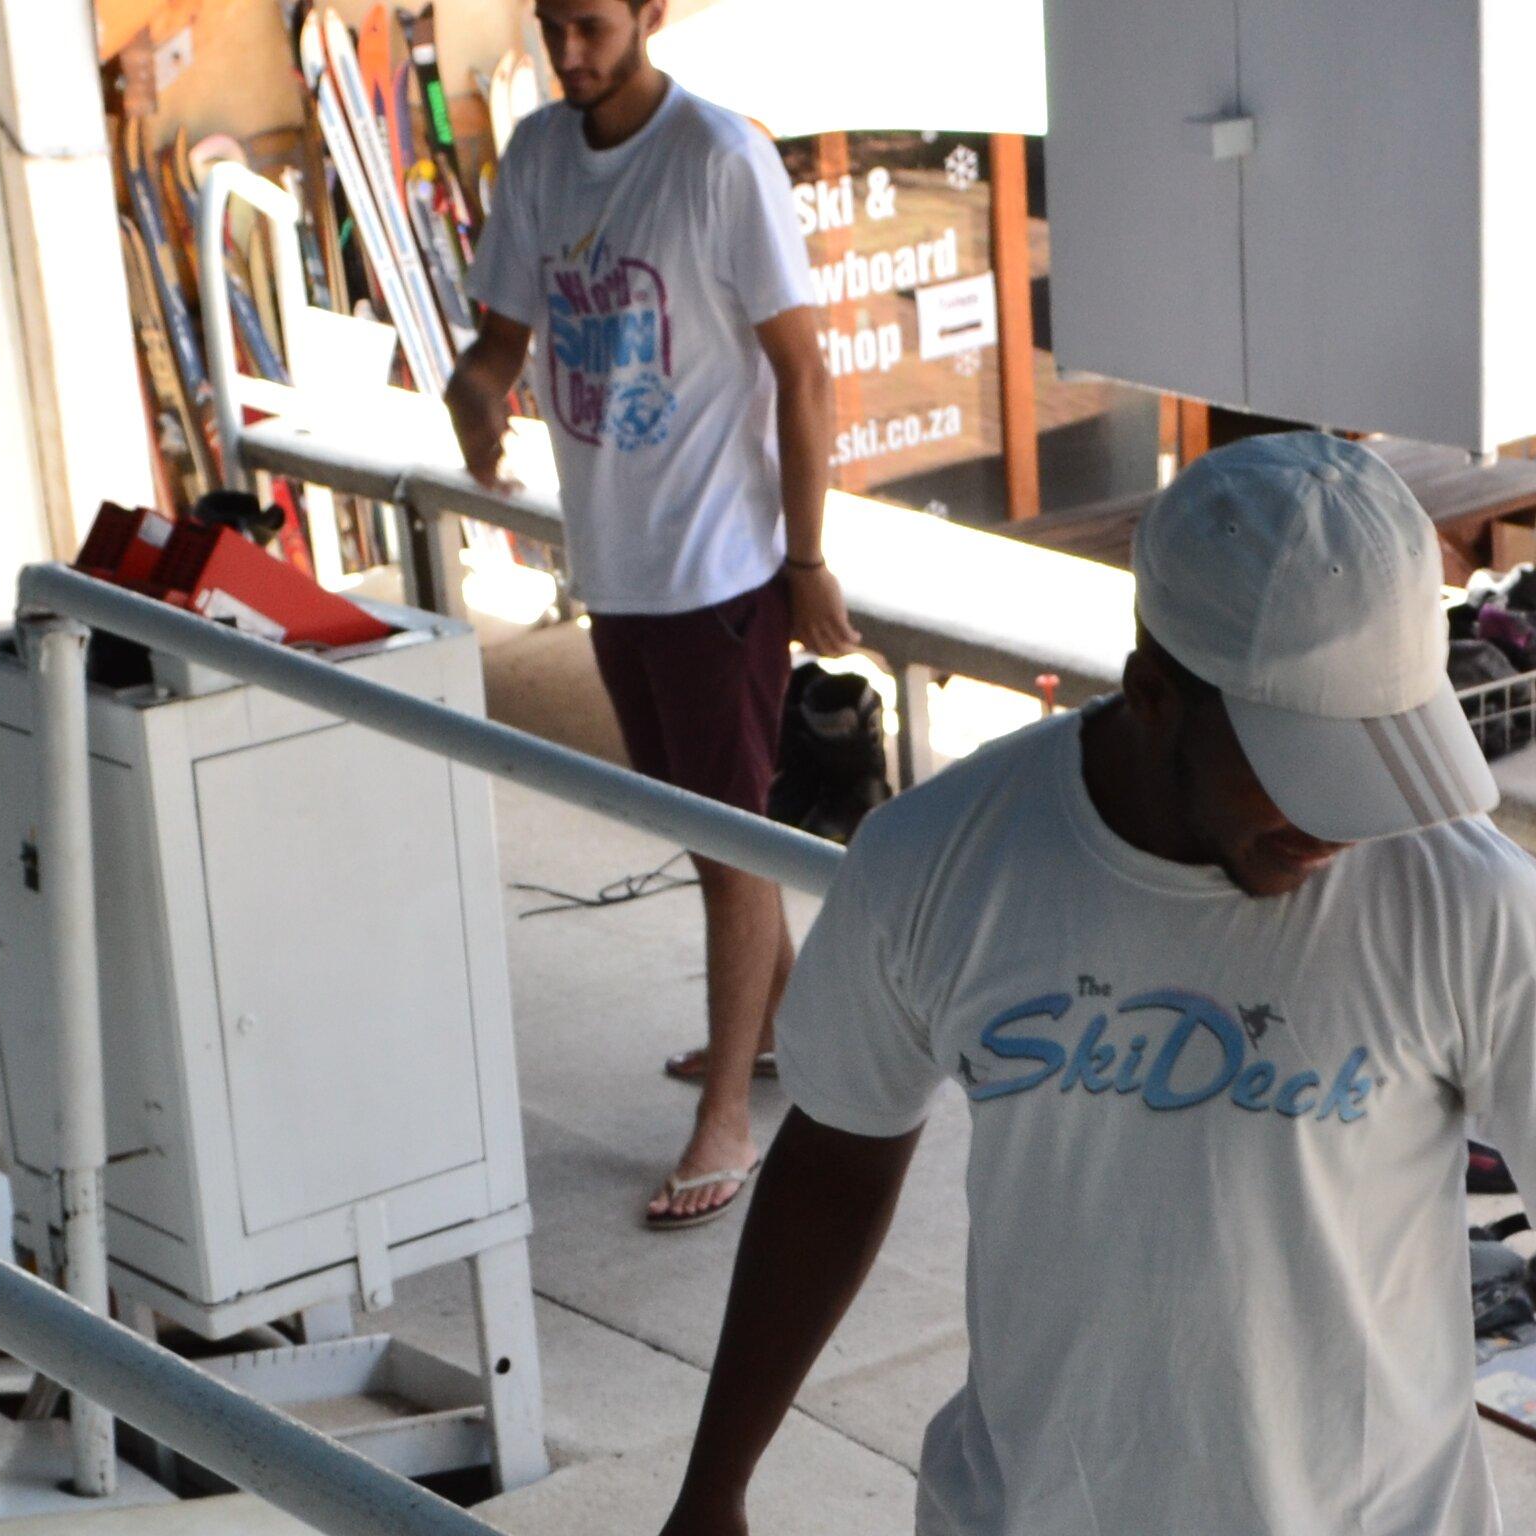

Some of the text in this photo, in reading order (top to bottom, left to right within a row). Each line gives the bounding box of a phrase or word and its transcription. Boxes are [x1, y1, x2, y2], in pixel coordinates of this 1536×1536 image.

[793, 166, 897, 236] Ski &
[1077, 974, 1112, 997] The
